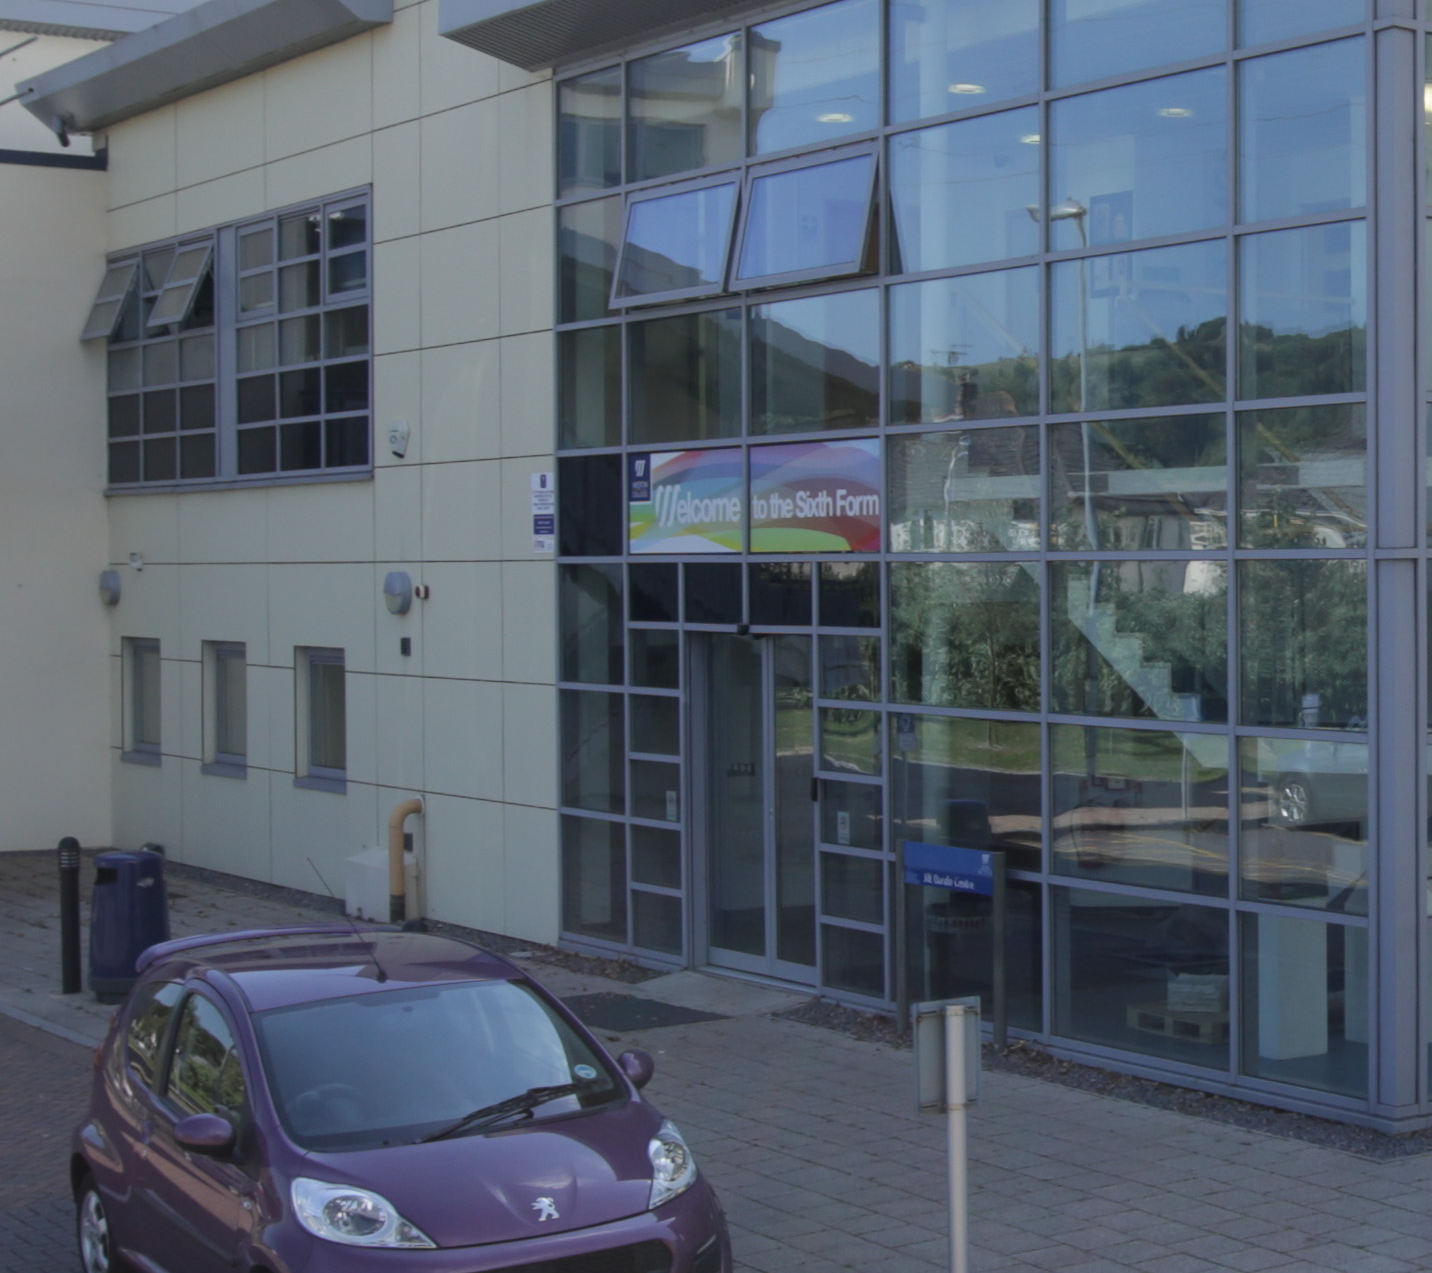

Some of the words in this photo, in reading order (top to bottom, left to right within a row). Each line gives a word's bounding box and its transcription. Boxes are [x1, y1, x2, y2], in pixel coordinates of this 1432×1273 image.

[655, 484, 741, 528] Welcome
[751, 494, 767, 519] to
[770, 492, 793, 519] the
[795, 490, 833, 518] Sixth
[836, 489, 880, 516] Form
